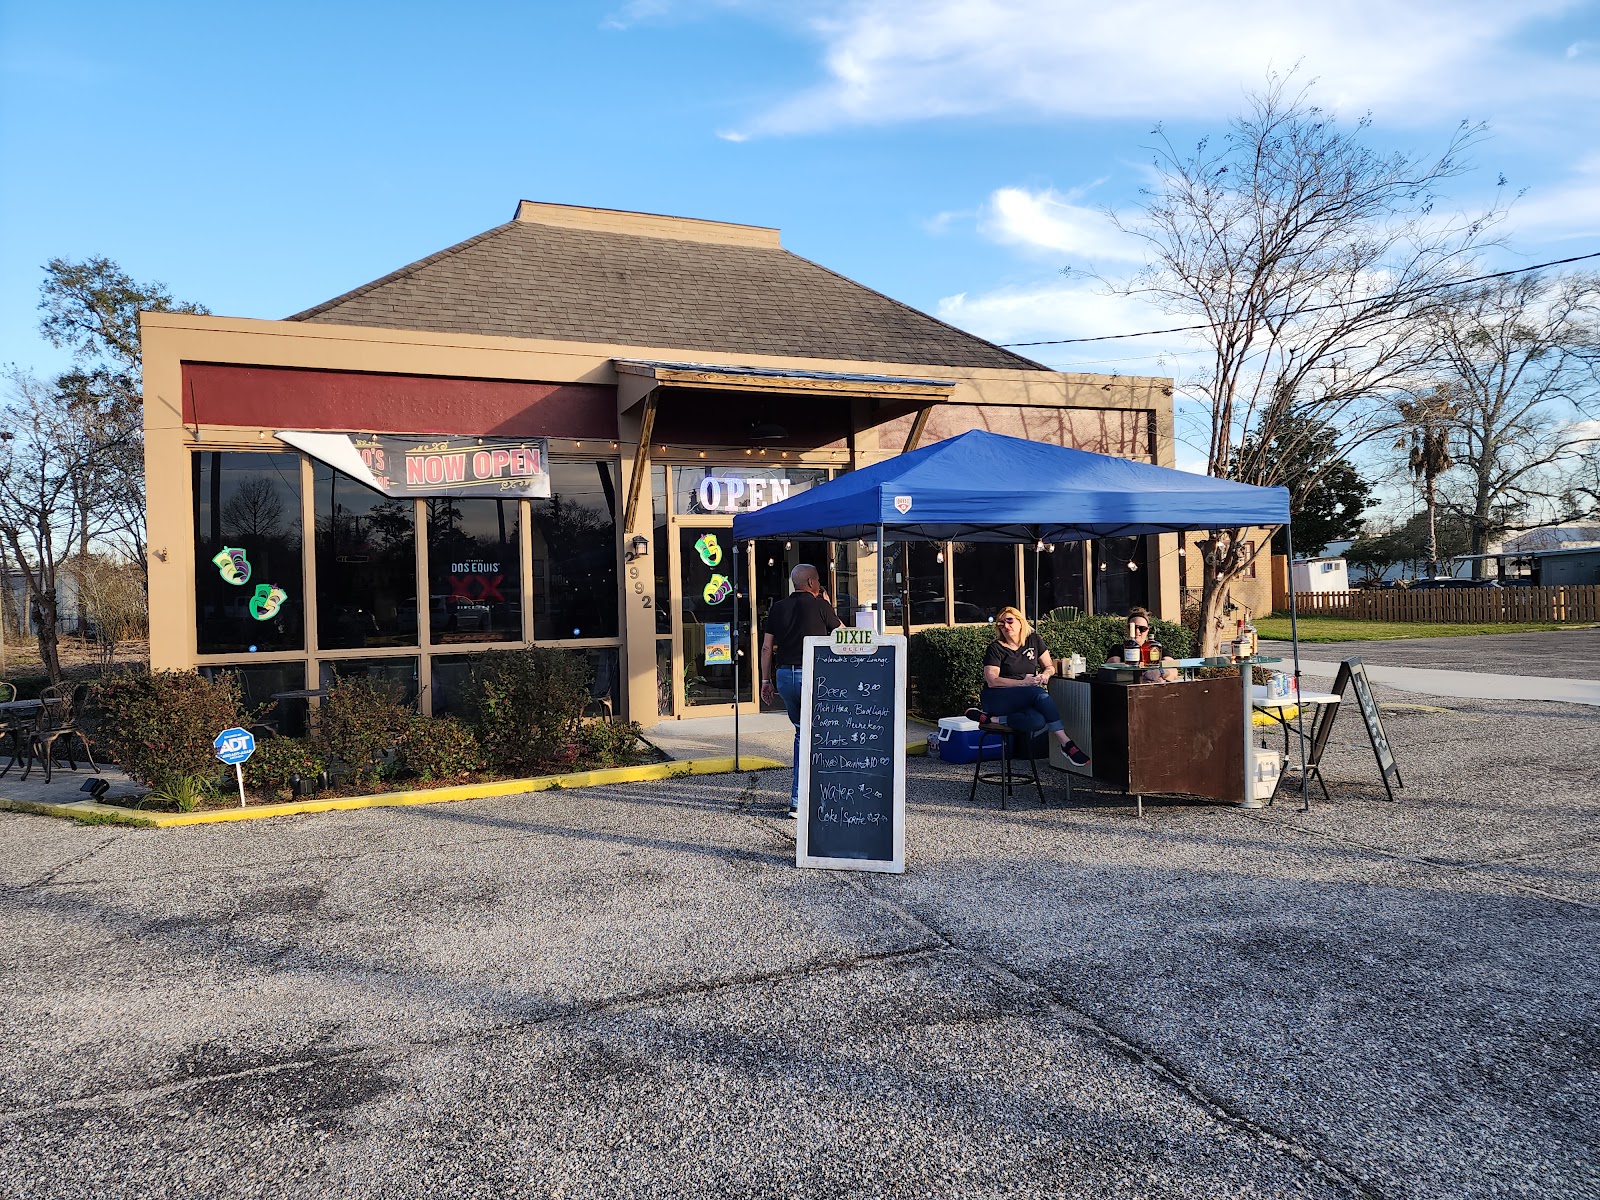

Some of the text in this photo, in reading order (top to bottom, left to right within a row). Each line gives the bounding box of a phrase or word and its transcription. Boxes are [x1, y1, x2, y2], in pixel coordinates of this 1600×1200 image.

[405, 449, 541, 485] NOW OPEN
[700, 476, 791, 512] OPEN
[451, 562, 499, 574] DOS EQUIS
[624, 551, 652, 609] 2992
[448, 574, 505, 602] XX
[835, 630, 872, 644] DIXIE
[220, 735, 250, 755] ADT
[813, 731, 849, 746] Shots
